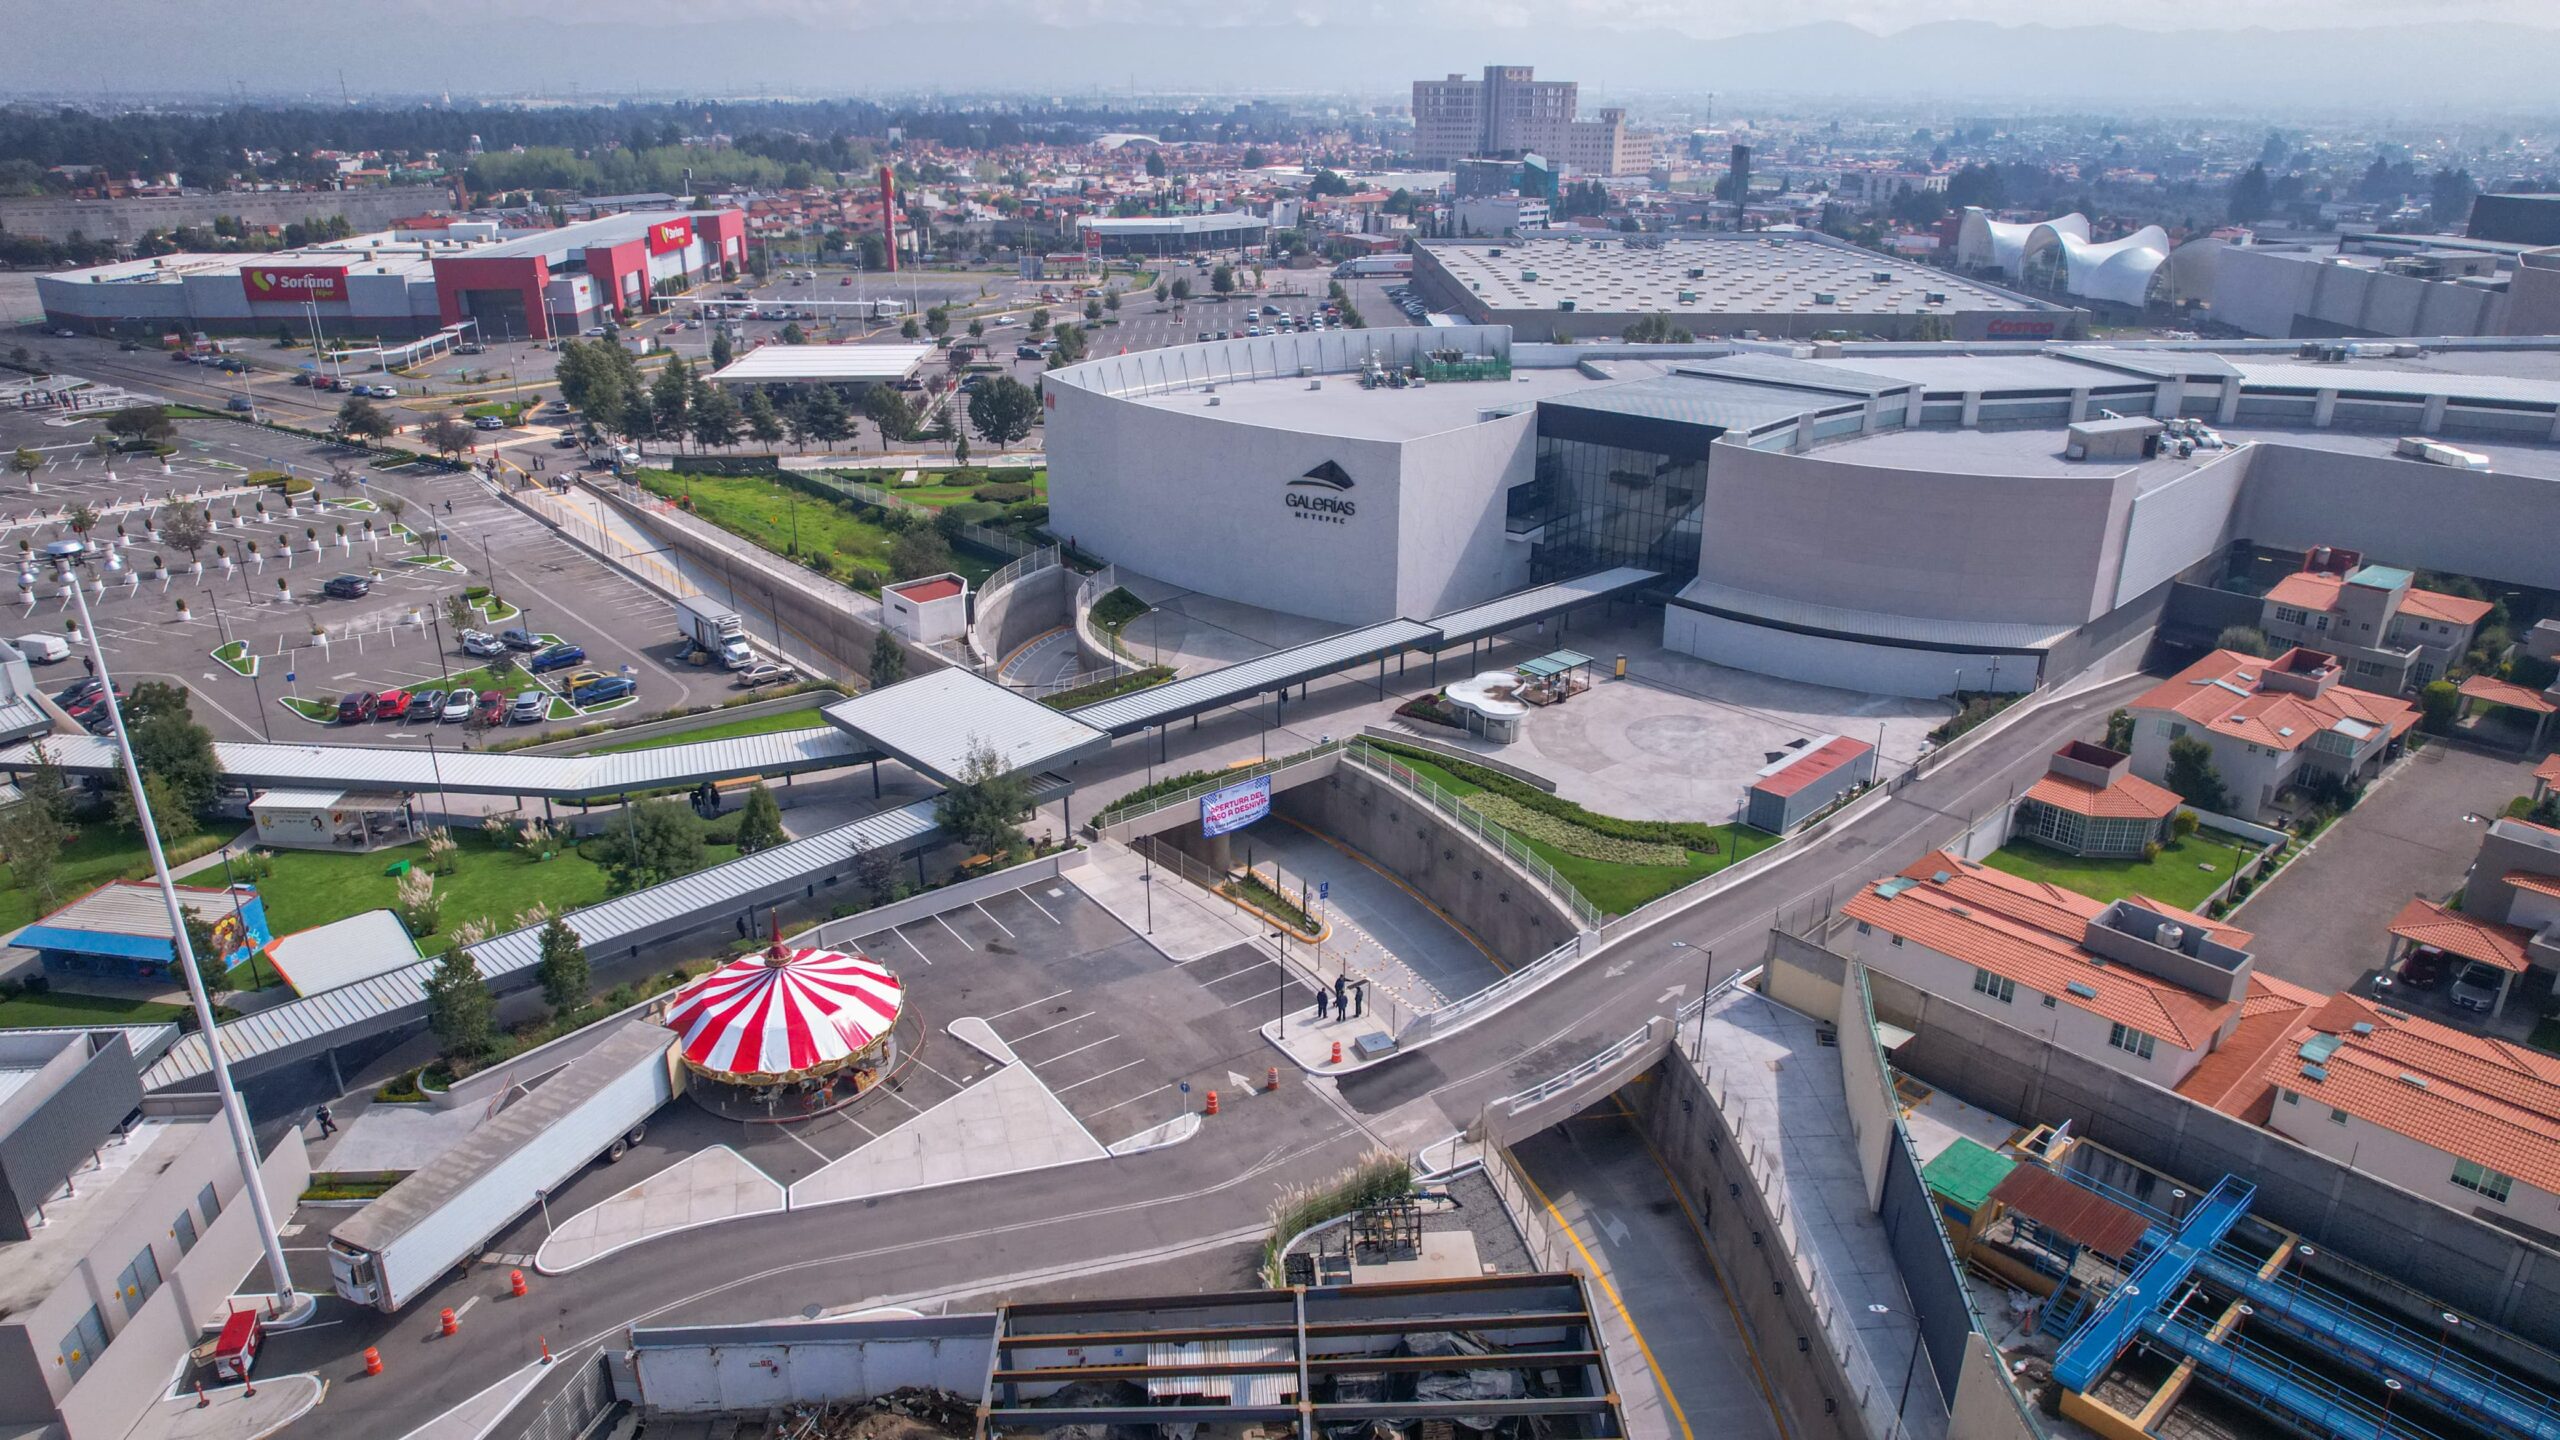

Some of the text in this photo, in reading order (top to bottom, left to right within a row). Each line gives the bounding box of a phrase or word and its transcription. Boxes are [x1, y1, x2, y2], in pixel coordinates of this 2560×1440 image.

[280, 275, 333, 288] Soriana
[1295, 511, 1345, 524] METEPEC
[1210, 796, 1249, 815] APERTURA
[1250, 791, 1265, 801] DEL
[1206, 812, 1227, 823] PASO
[1228, 809, 1234, 817] A
